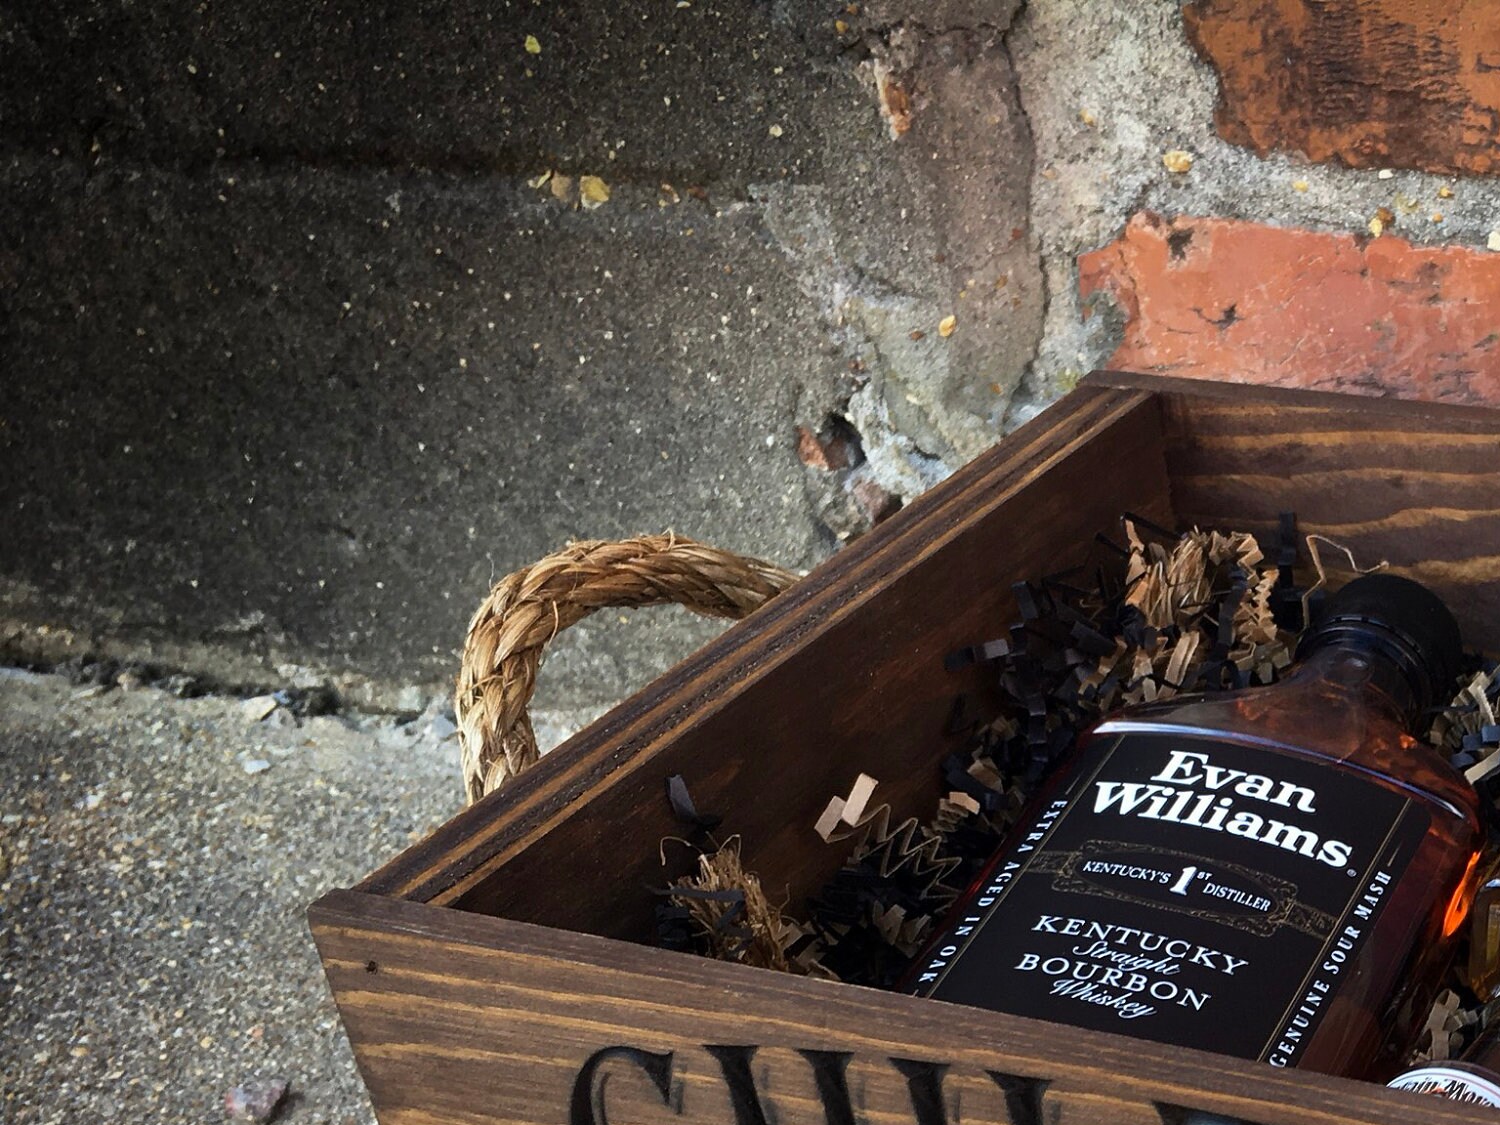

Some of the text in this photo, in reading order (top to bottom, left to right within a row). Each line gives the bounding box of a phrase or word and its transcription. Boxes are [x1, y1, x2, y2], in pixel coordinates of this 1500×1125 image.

[1151, 749, 1317, 813] Evan
[1093, 781, 1353, 869] Williams
[919, 800, 1068, 982] EXTRA AGED IN OAK
[1082, 860, 1172, 884] KENTUCKY'S
[1202, 882, 1272, 912] DISTILLER
[1031, 915, 1249, 976] KENTUCKY
[1072, 940, 1181, 976] Straight
[1269, 871, 1392, 1068] GENUINE SOUR MASH
[1014, 953, 1212, 1012] BOURBON
[1049, 979, 1157, 1019] Whiskey
